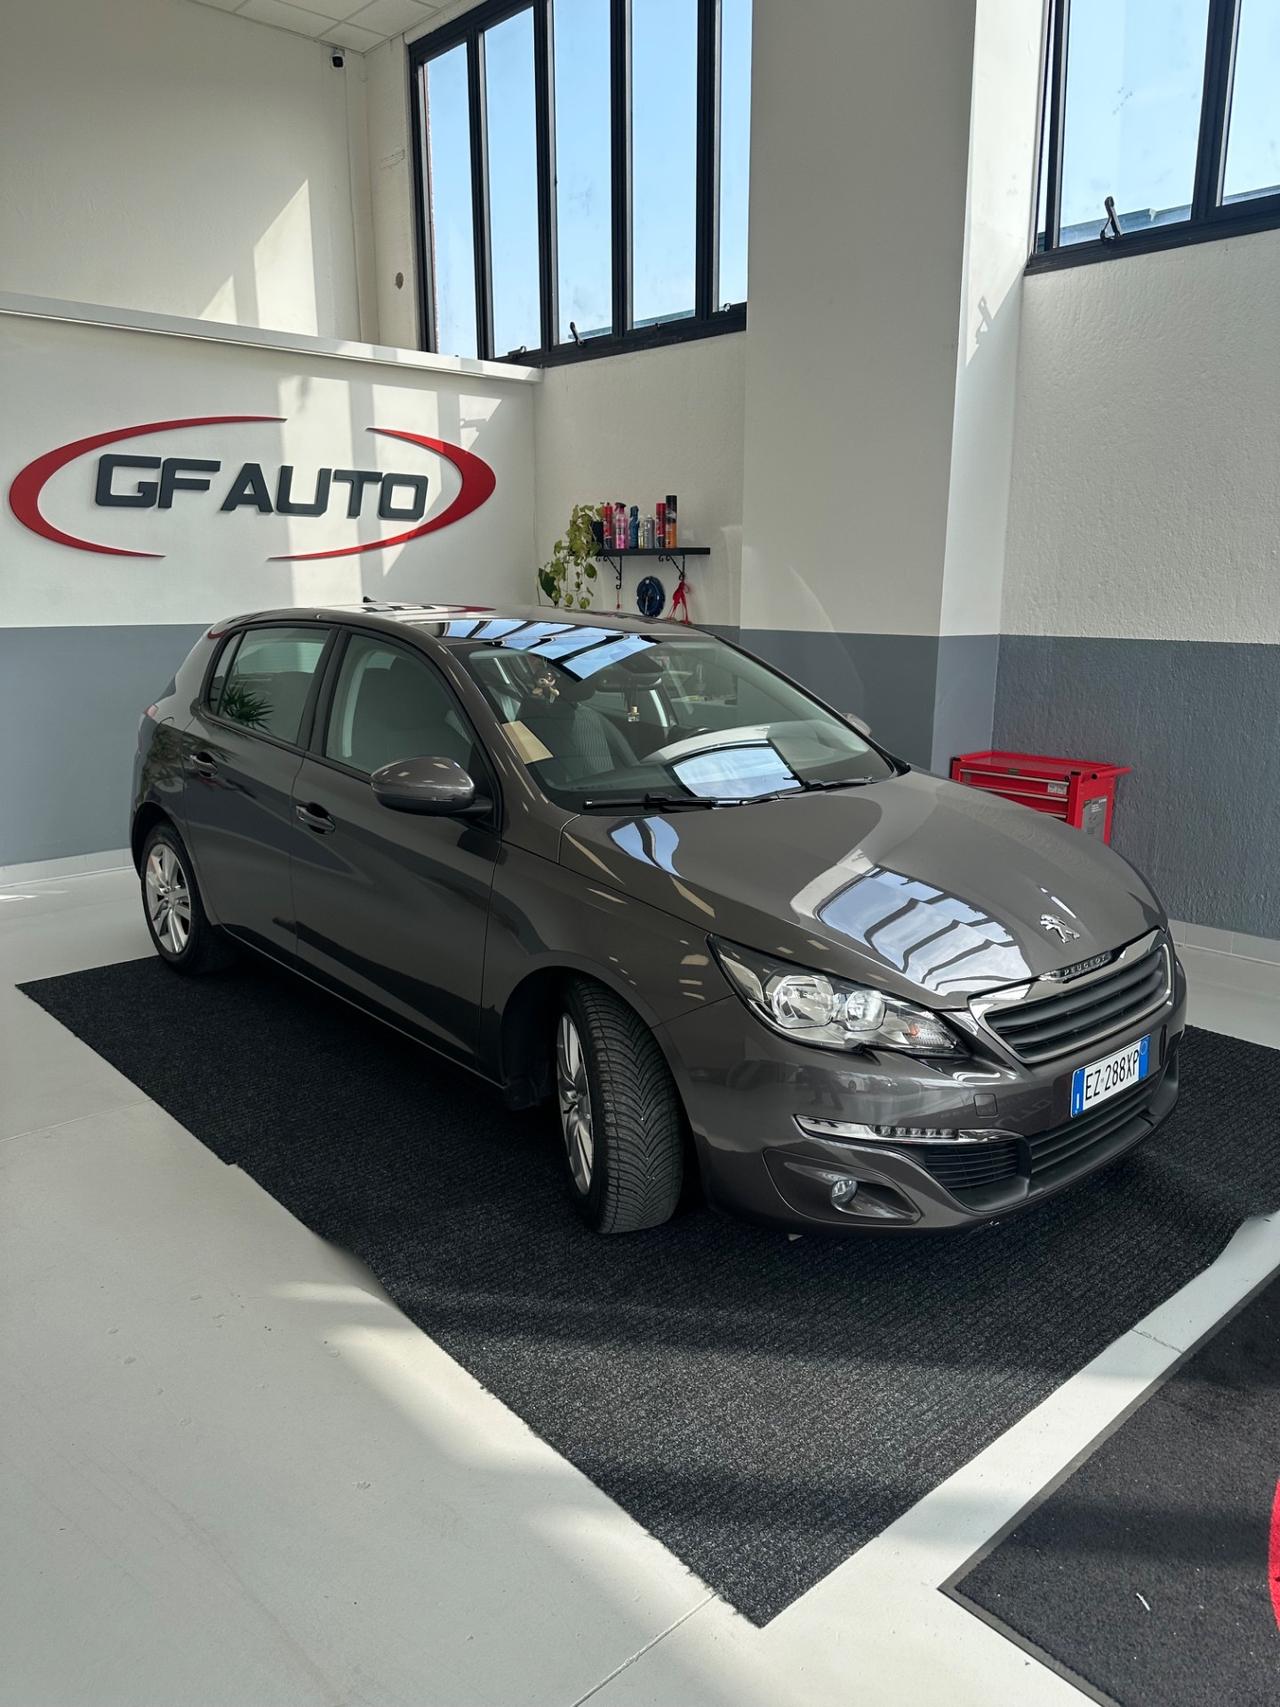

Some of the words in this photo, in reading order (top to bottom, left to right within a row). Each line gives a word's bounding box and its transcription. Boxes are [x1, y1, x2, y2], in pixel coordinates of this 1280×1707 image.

[95, 453, 221, 509] GF
[220, 463, 429, 520] AUTO
[1063, 954, 1107, 976] PEUGEOT
